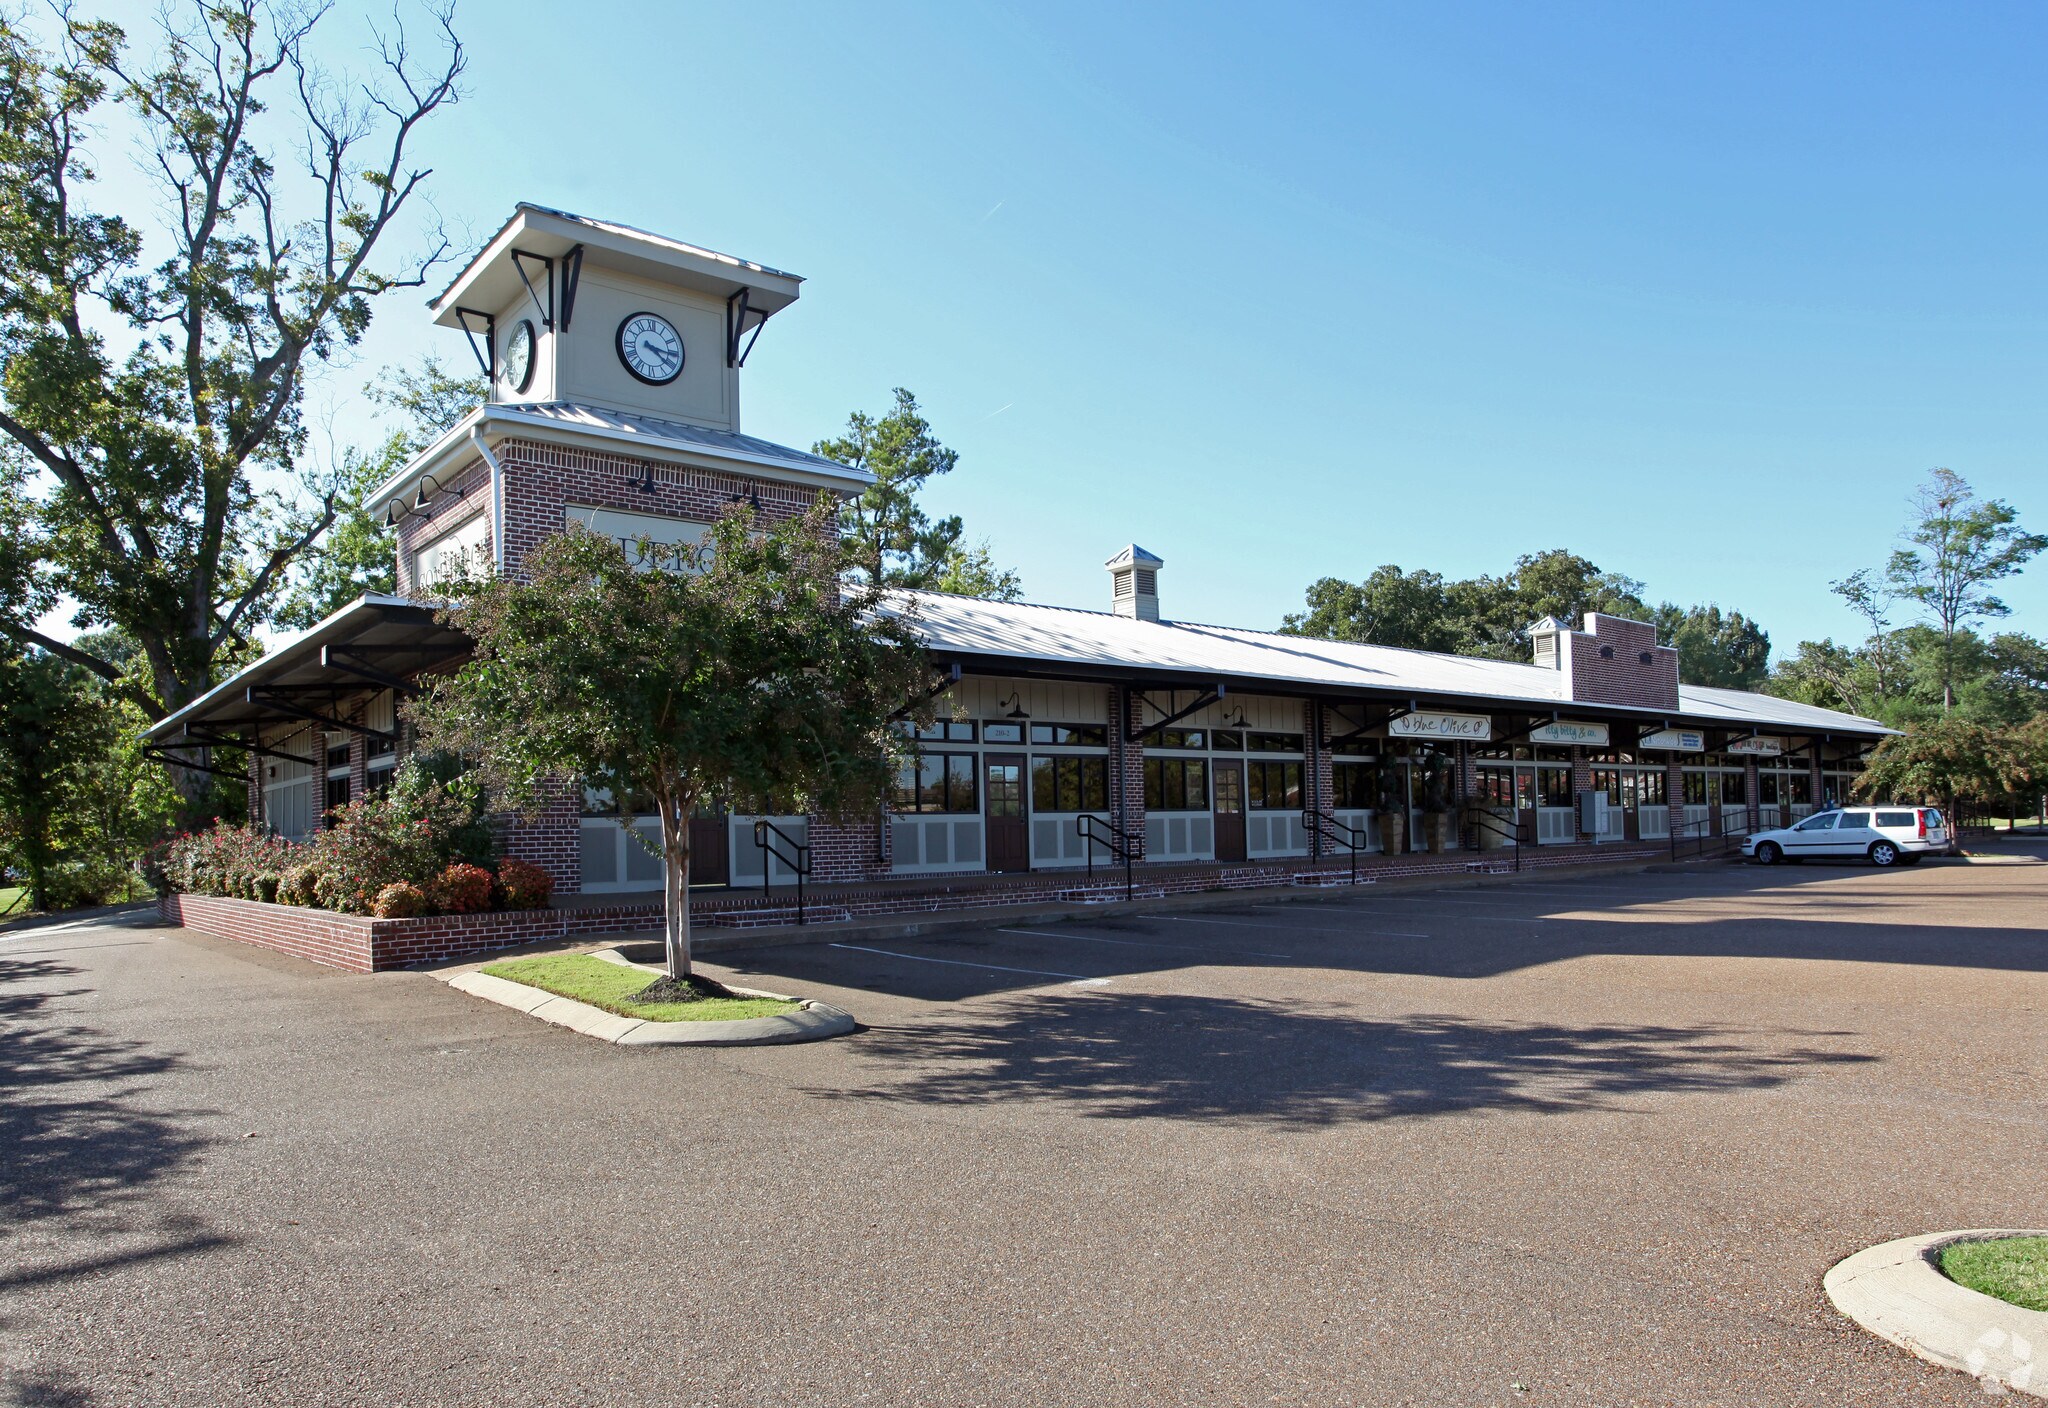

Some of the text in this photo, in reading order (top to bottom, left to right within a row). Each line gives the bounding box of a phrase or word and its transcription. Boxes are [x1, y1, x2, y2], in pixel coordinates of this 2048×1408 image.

[617, 537, 728, 574] DEPO
[1413, 715, 1471, 734] blue Olive
[1560, 724, 1577, 740] bitty
[1578, 727, 1586, 739] &
